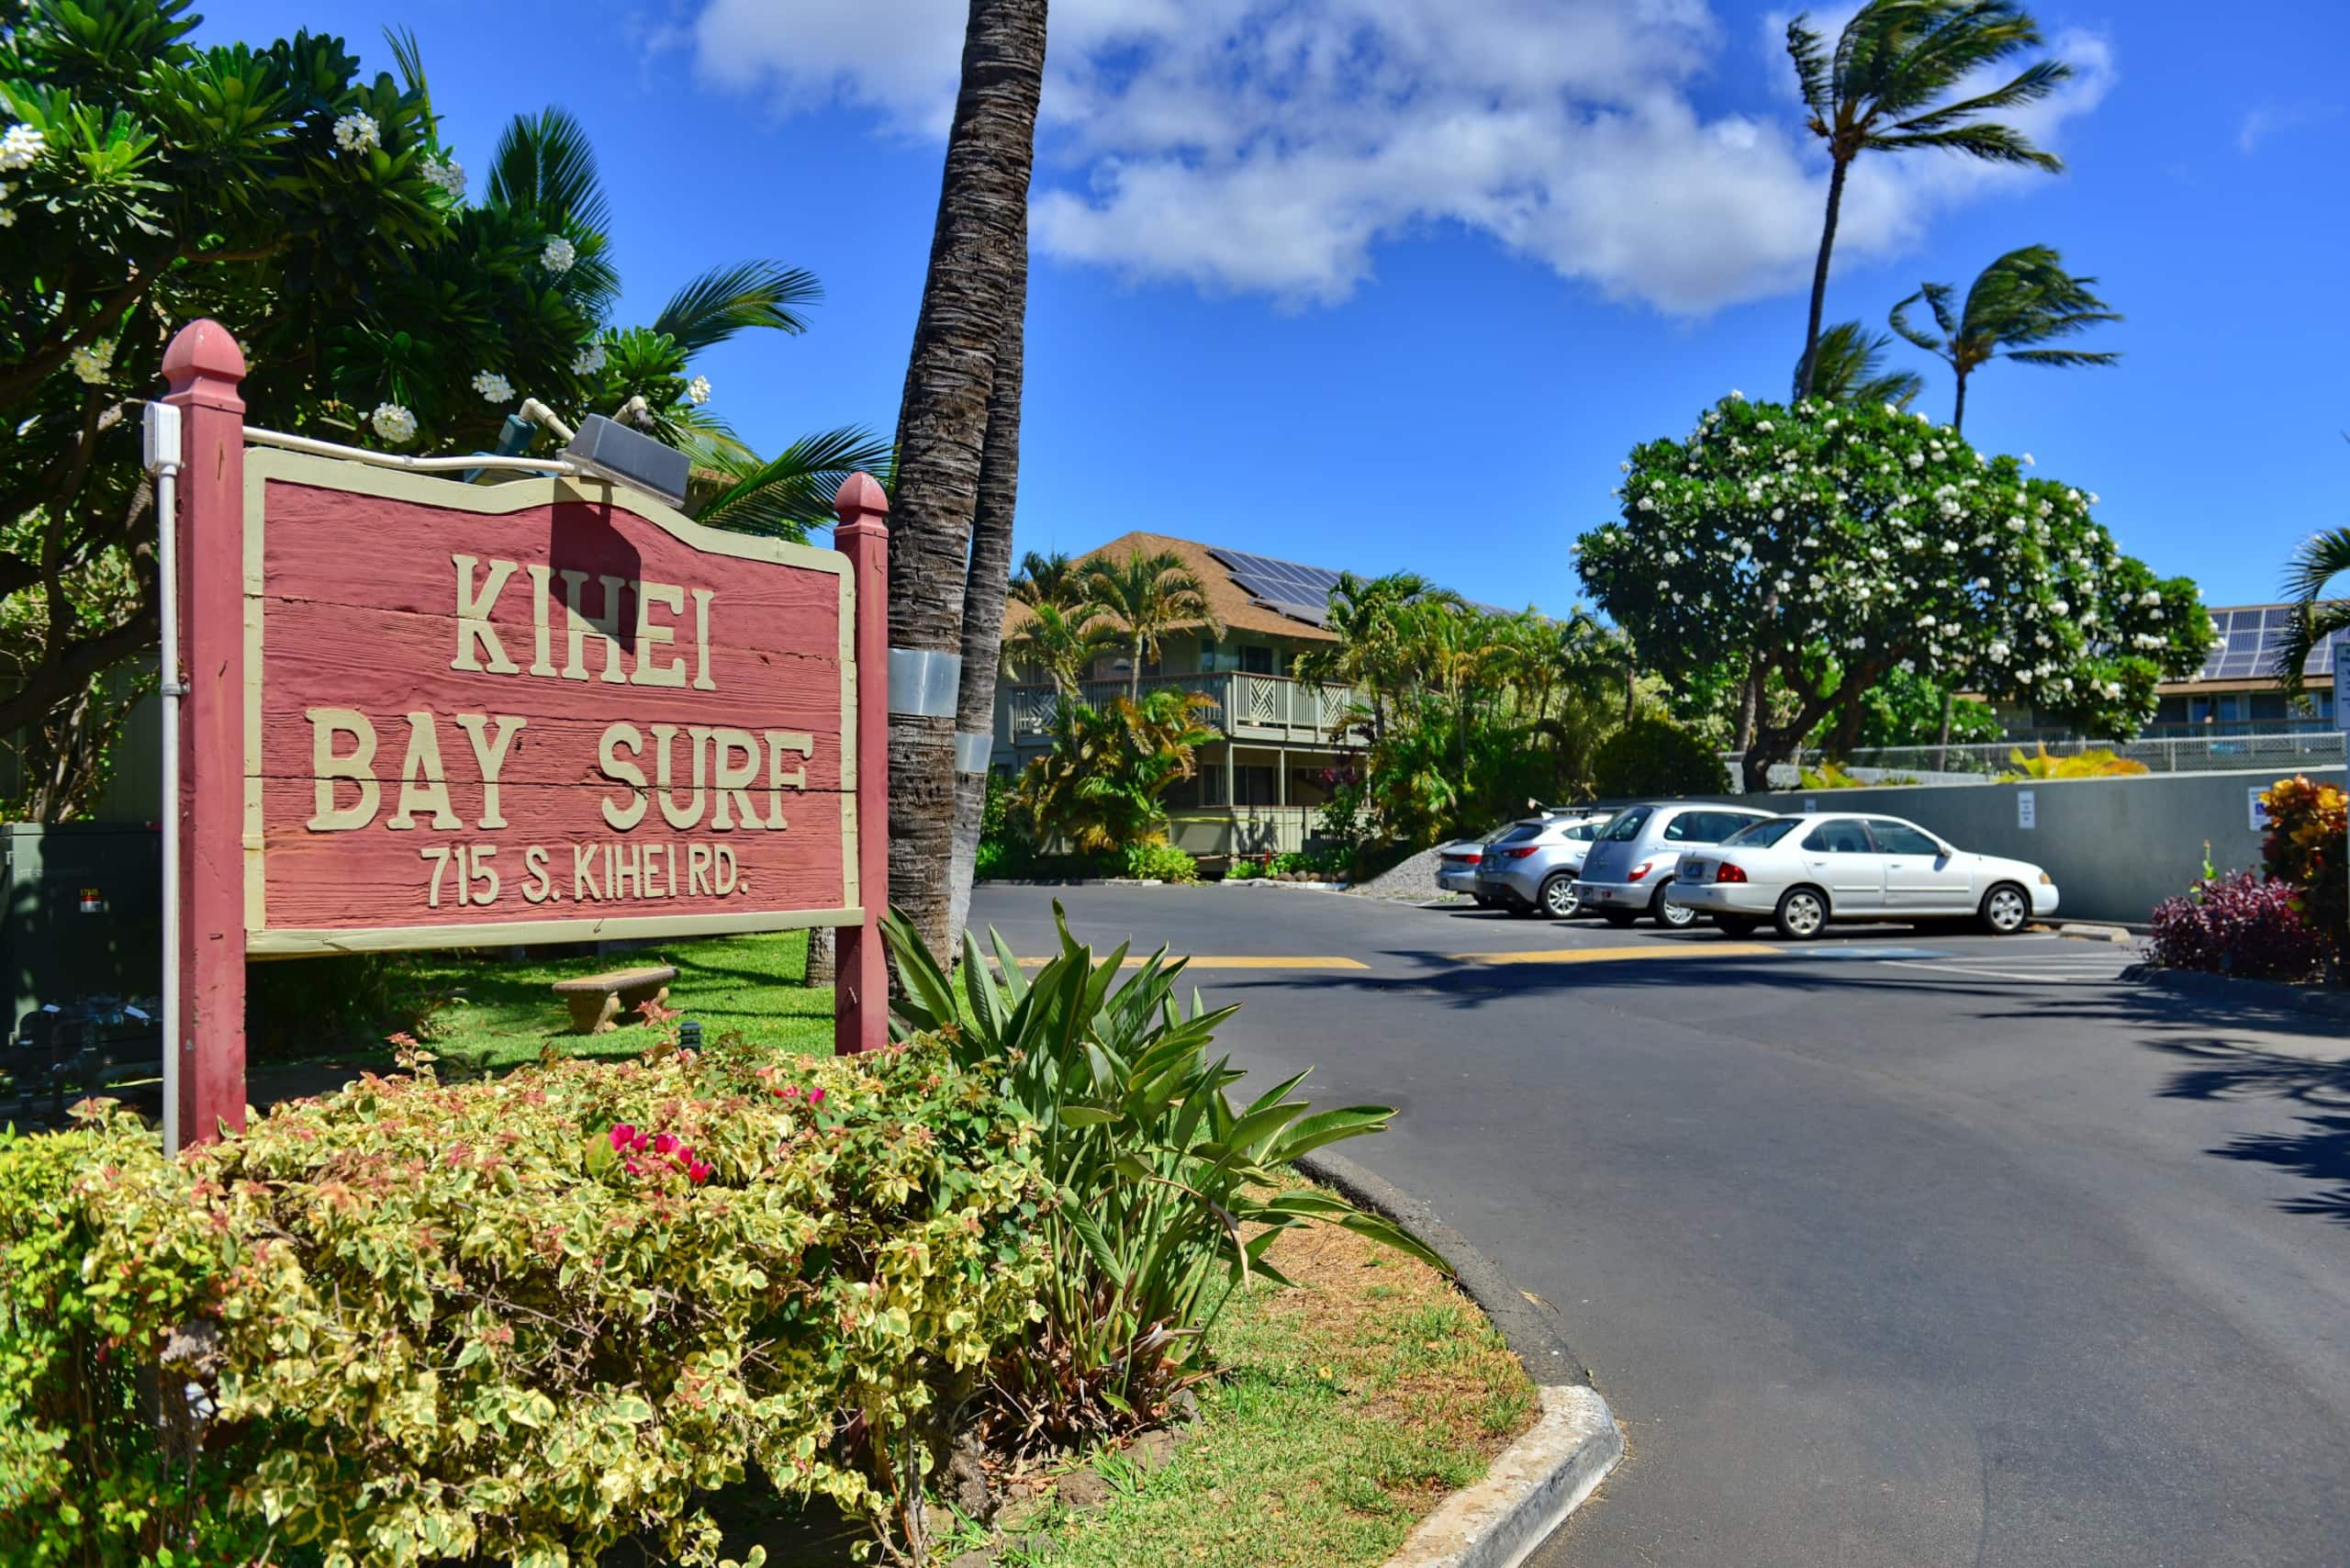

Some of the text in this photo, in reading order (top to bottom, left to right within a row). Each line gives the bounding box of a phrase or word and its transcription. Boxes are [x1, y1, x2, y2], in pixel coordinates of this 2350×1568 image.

[450, 554, 716, 690] KIHEI
[306, 708, 812, 832] BAY SURF
[420, 844, 749, 907] 715 S. KIHEI RD.
